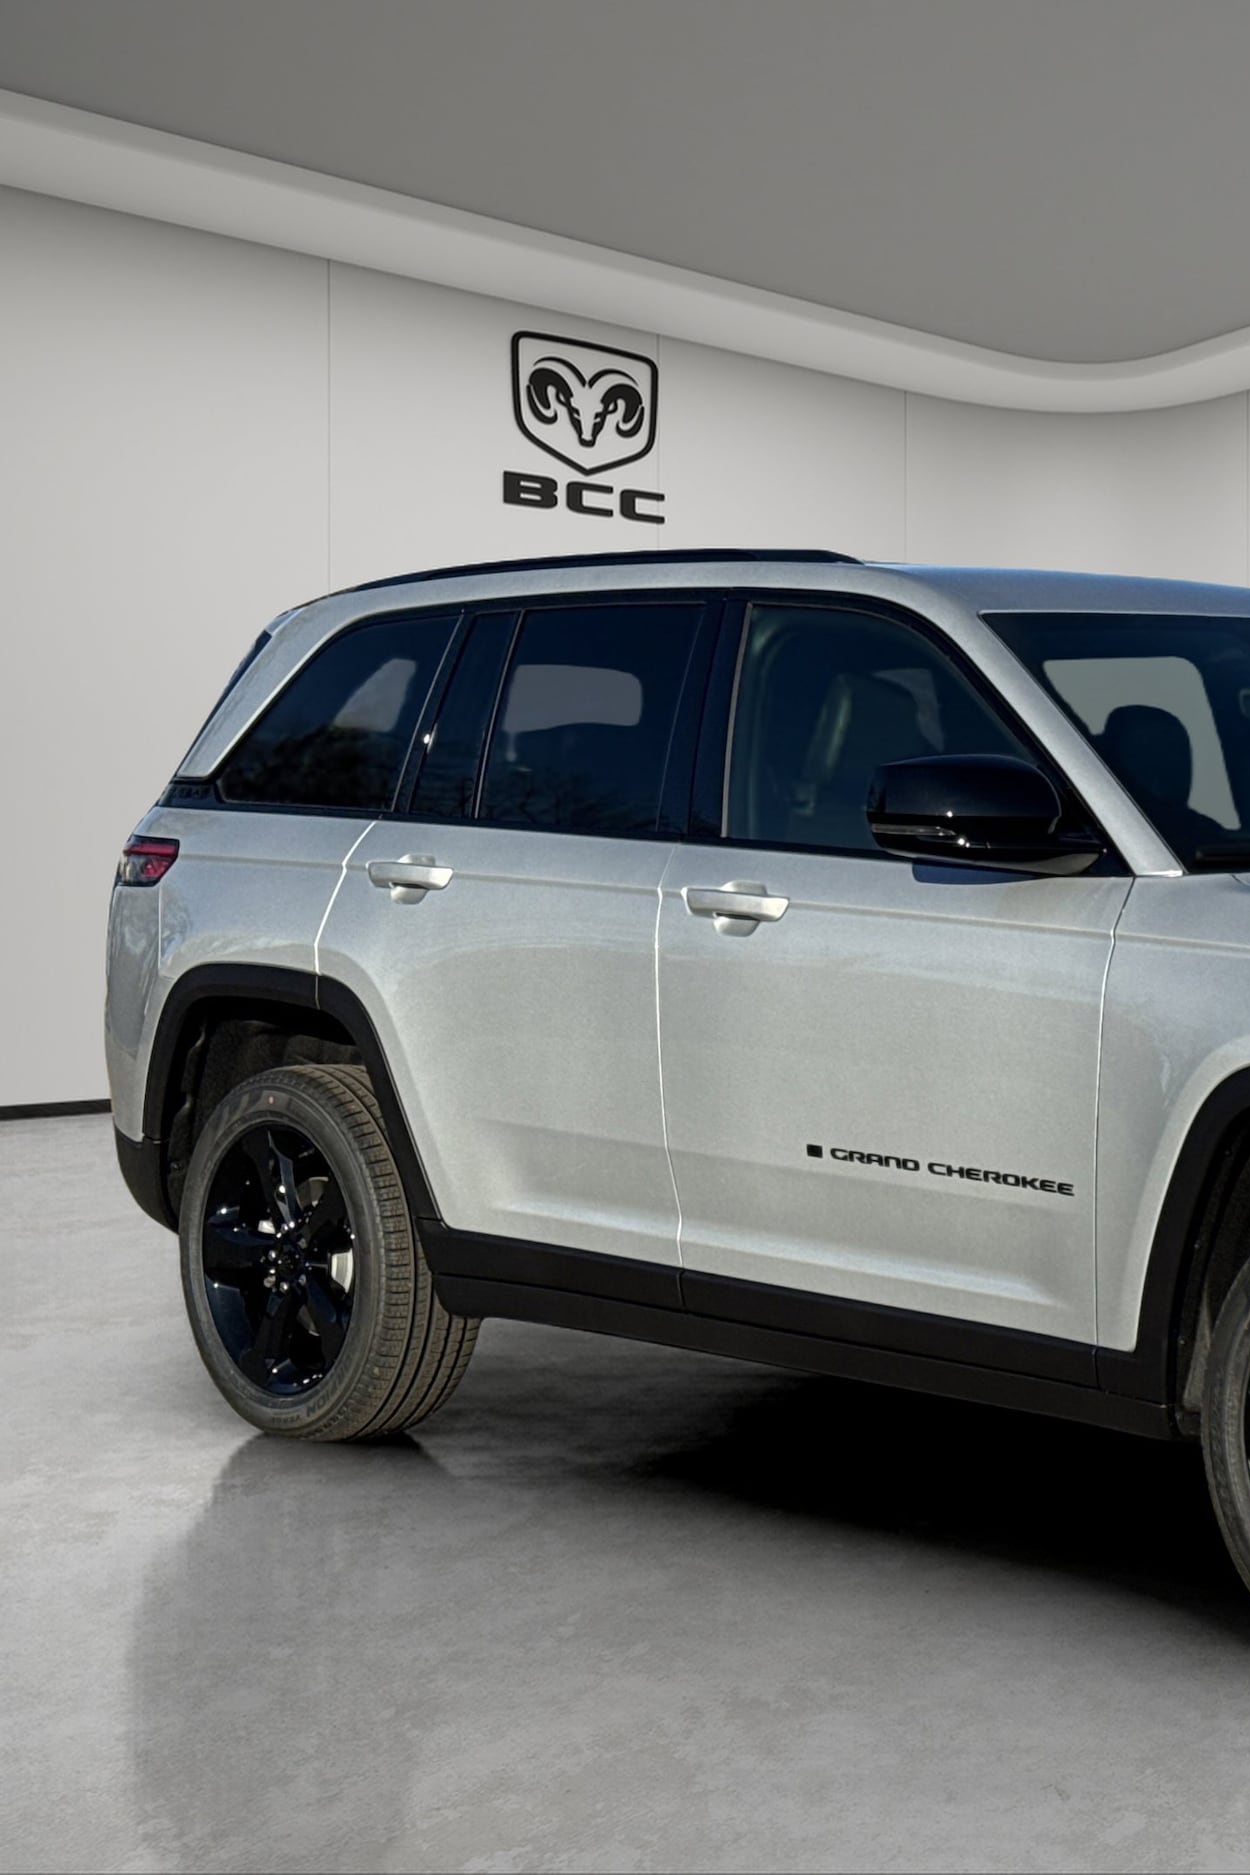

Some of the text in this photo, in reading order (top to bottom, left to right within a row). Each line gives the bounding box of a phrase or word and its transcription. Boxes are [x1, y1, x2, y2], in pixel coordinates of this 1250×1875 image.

[503, 470, 665, 524] BCC
[830, 1147, 1075, 1196] GRAND CHEROKEE
